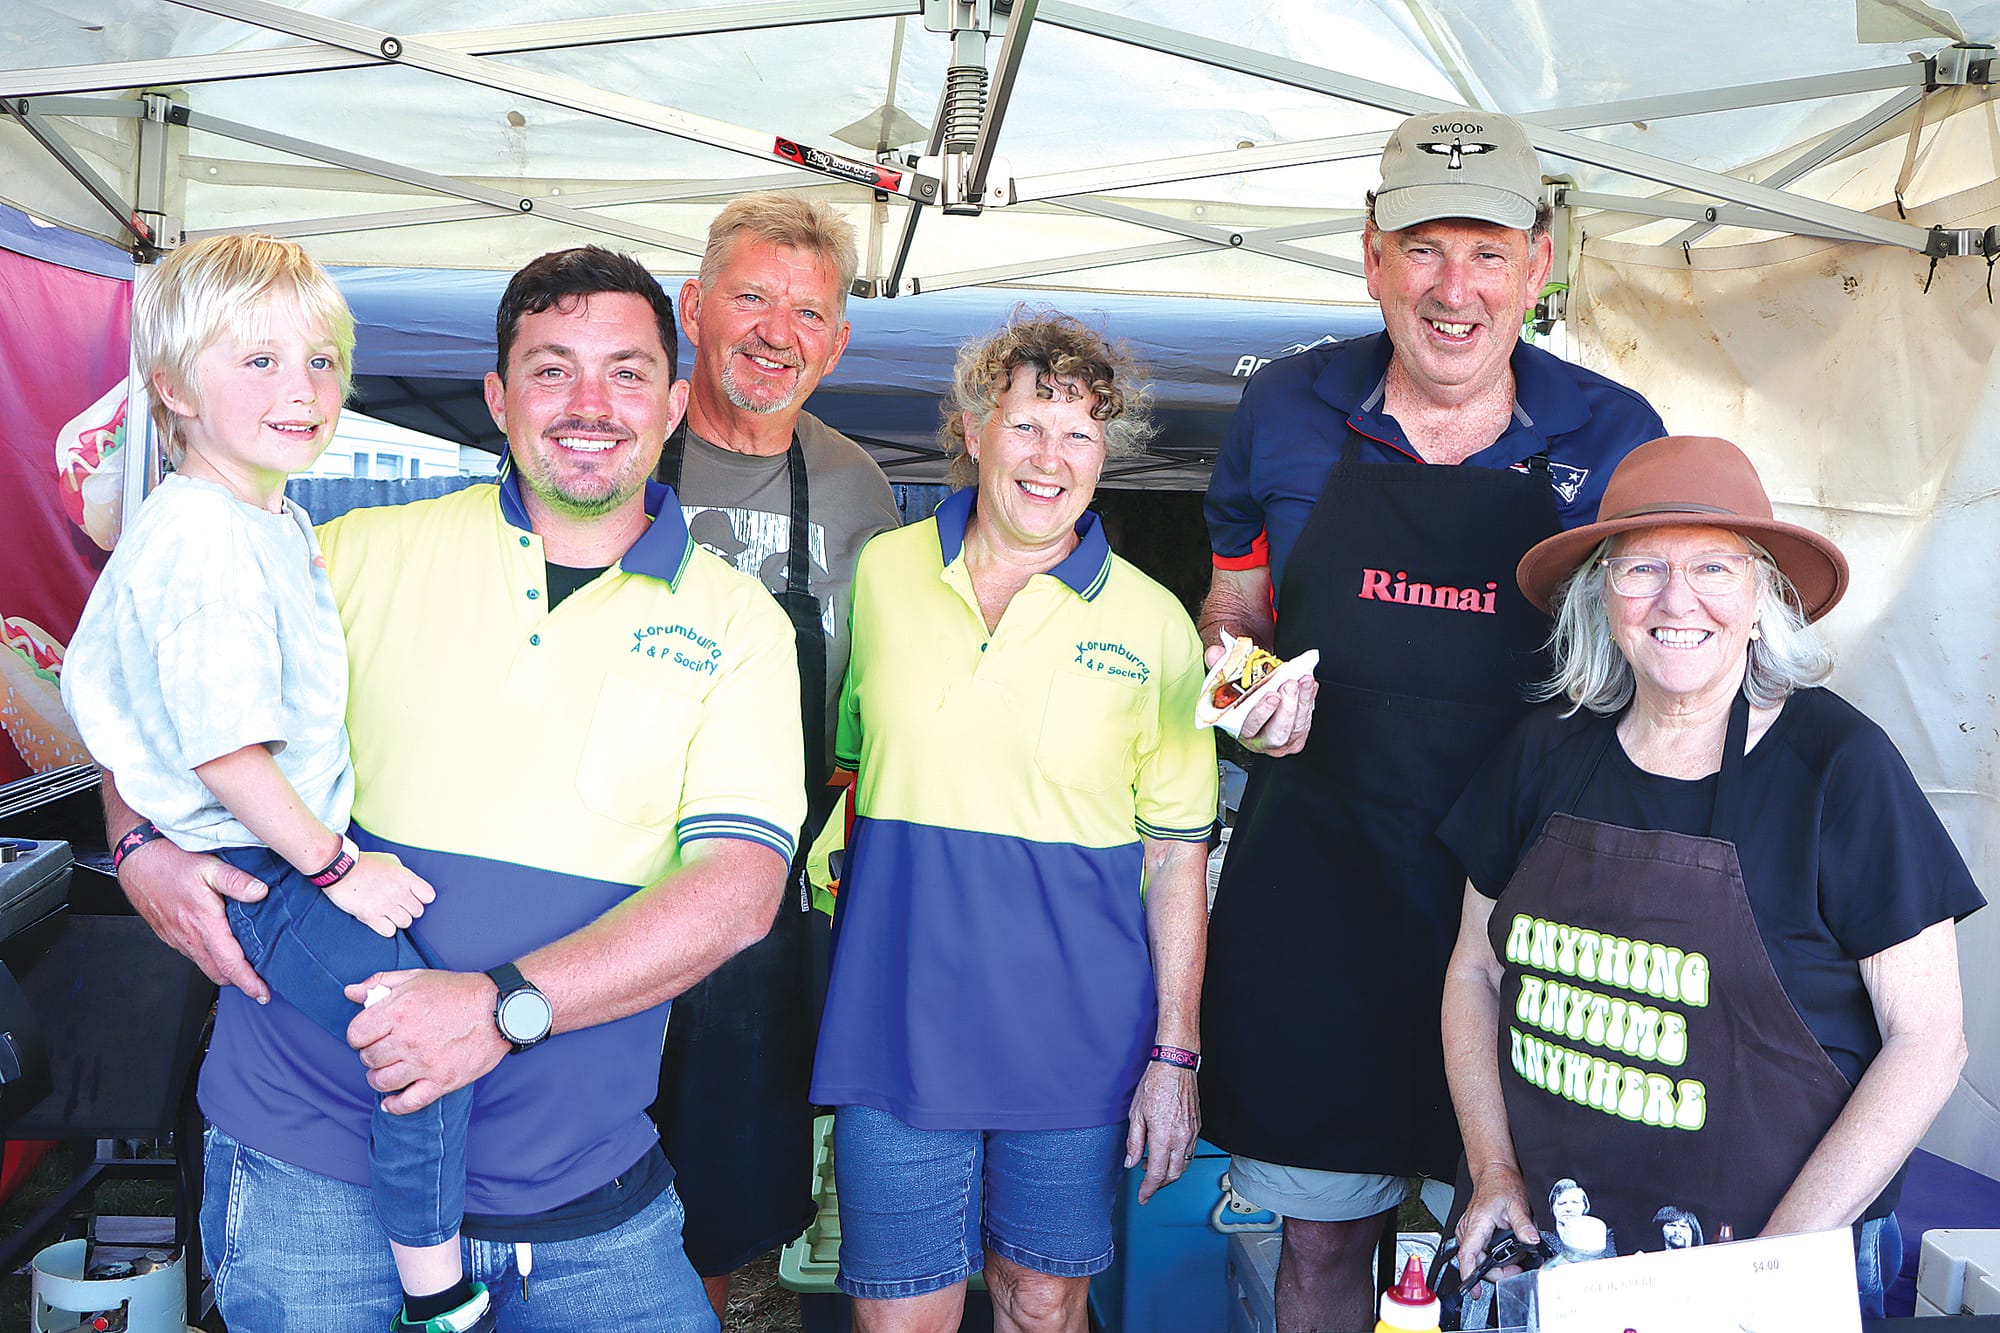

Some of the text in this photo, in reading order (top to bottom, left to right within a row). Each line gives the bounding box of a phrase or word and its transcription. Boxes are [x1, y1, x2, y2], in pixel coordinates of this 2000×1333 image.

[1431, 122, 1484, 135] SWOOP
[1358, 568, 1498, 614] Rinnai
[631, 642, 641, 653] A
[646, 645, 656, 658] &
[660, 647, 670, 659] P
[1076, 641, 1150, 675] Korumburra
[1074, 654, 1148, 685] A & P Society
[1506, 913, 1710, 1008] ANYTHING
[1516, 974, 1688, 1066] ANYTIME
[1509, 1025, 1707, 1131] ANYWHERE
[1753, 1259, 1779, 1273] $4.00
